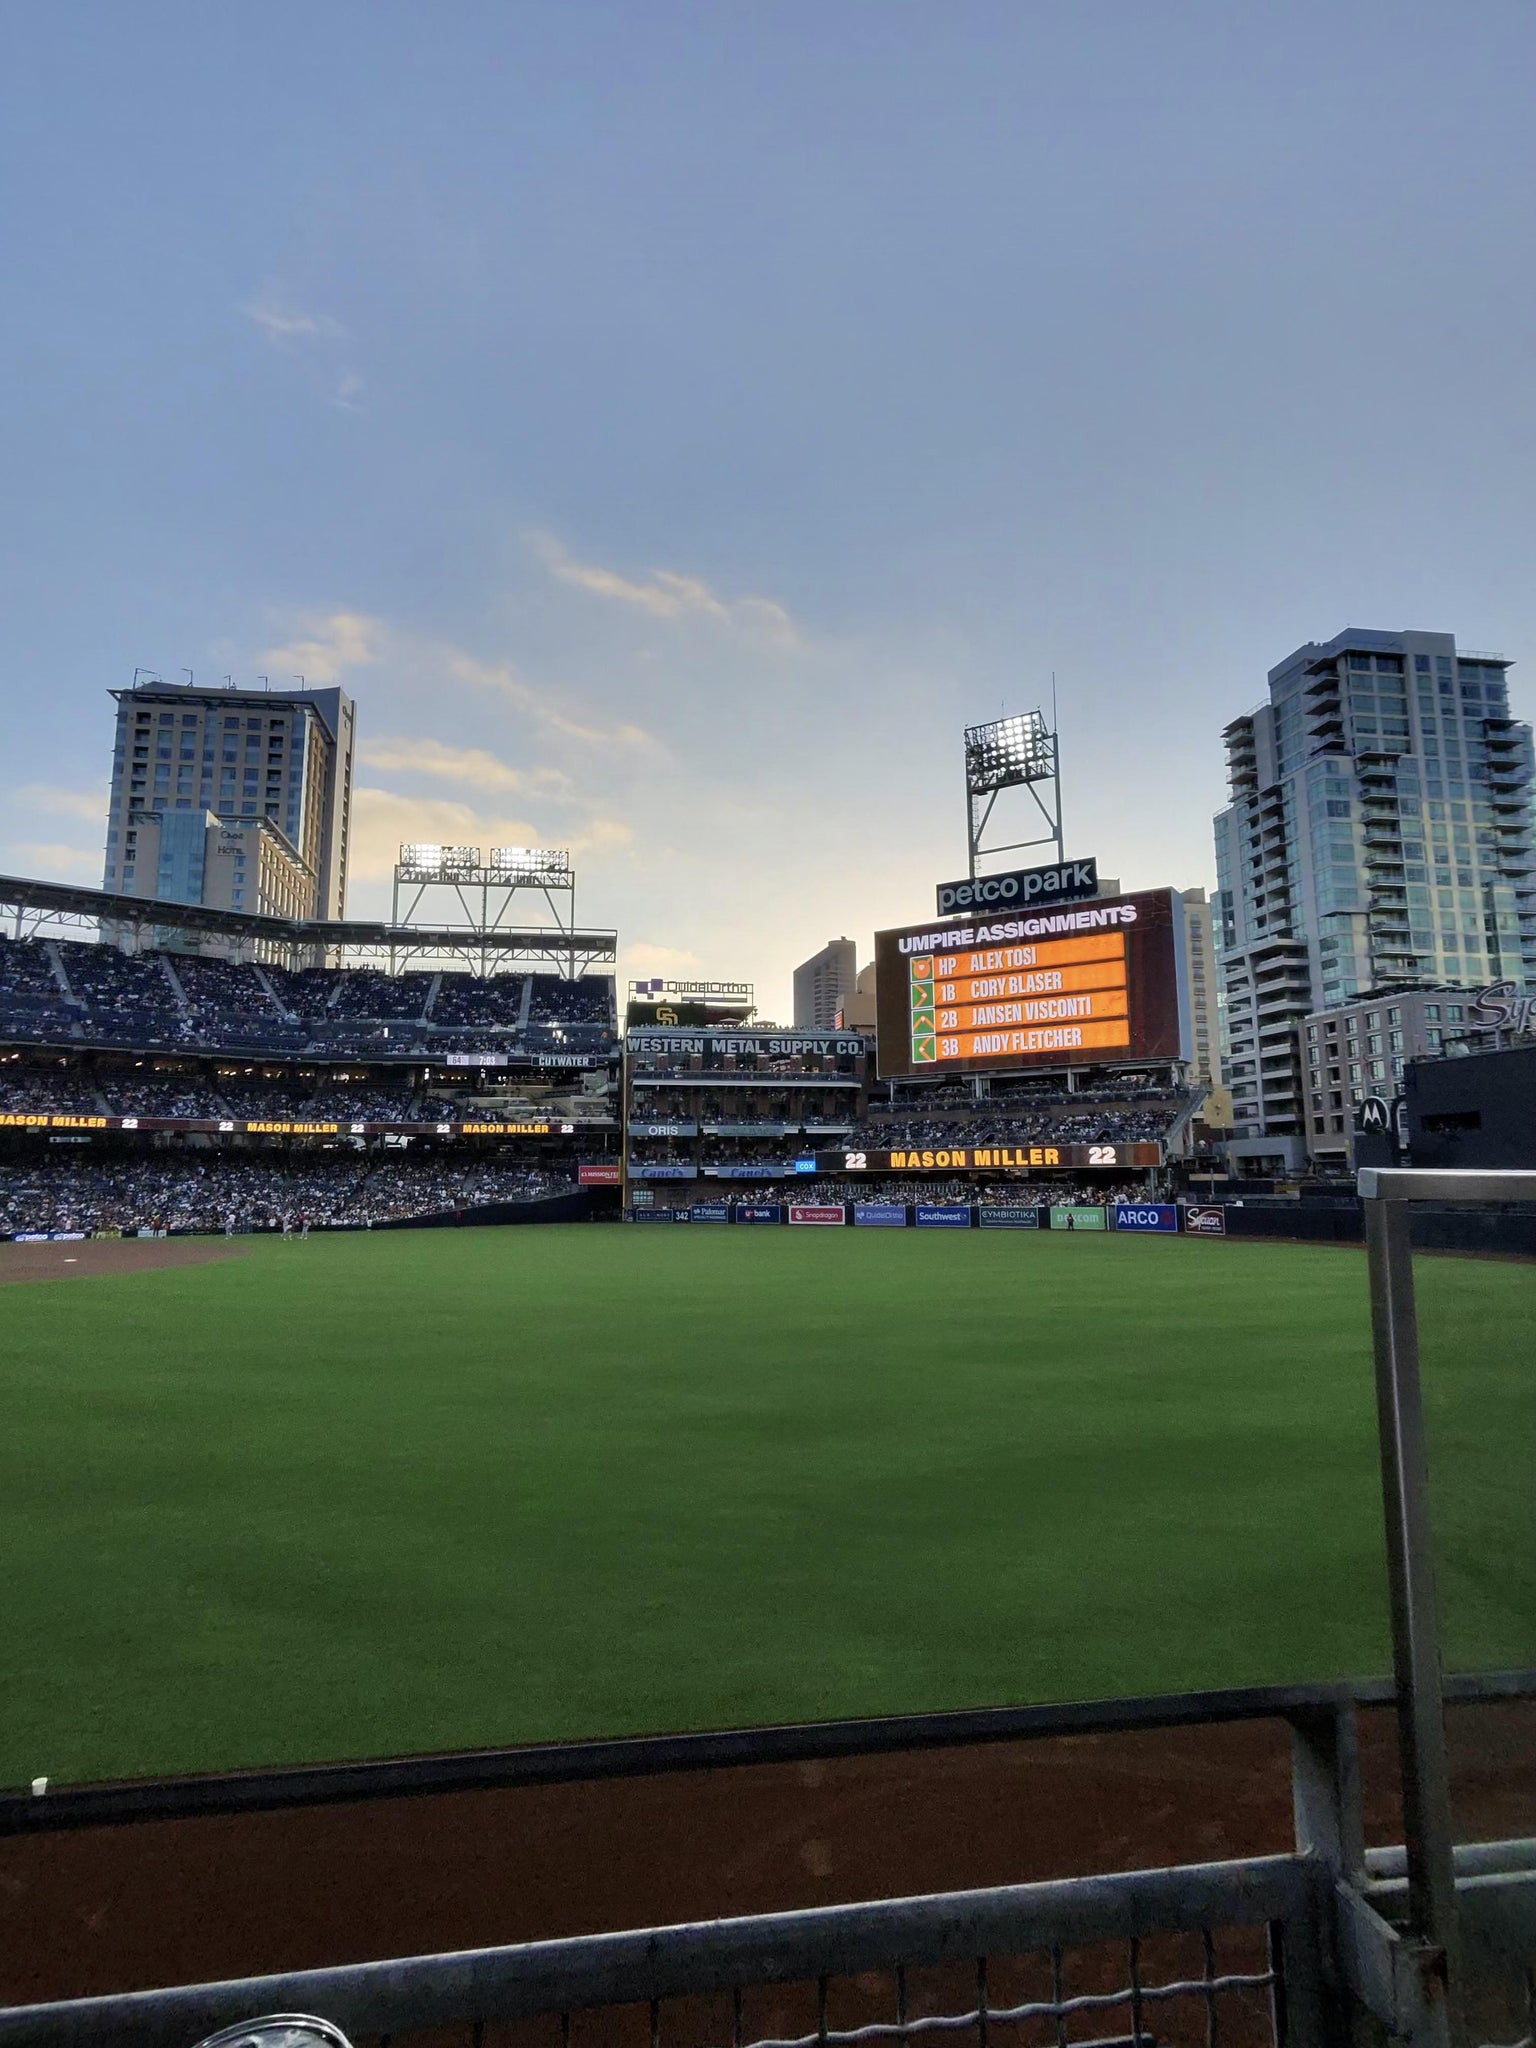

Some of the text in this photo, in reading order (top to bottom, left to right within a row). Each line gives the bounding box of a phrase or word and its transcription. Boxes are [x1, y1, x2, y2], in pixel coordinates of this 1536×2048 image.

[938, 863, 1093, 914] petco park
[898, 905, 1138, 953] UMPIRE ASSIGNMENTS
[970, 947, 1037, 972] ALEX TOSI
[938, 958, 957, 976] HP
[971, 971, 1062, 999] CORY BLASER
[941, 984, 956, 1002] 1B
[971, 997, 1091, 1026] JANSEN VISCONTI
[941, 1011, 958, 1028] 2B
[627, 1038, 863, 1055] WESTERN METAL SUPPLY CO.
[973, 1028, 1082, 1054] ANDY FLETCHER
[941, 1039, 958, 1056] 3B
[479, 1056, 496, 1065] 7:03
[538, 1057, 589, 1066] CUTWATER
[52, 1116, 106, 1127] MILLER
[121, 1118, 138, 1128] 22
[219, 1121, 234, 1131] 22
[247, 1122, 338, 1133] MASON MILLER
[350, 1124, 364, 1133] 22
[437, 1124, 450, 1133] 22
[462, 1124, 549, 1133] MASON MILLER
[561, 1124, 574, 1133] 22
[648, 1126, 678, 1136] ORIS
[845, 1152, 867, 1169] 22
[890, 1148, 1059, 1168] MASON MILLER
[1088, 1146, 1116, 1165] 22
[675, 1211, 688, 1220] 342
[754, 1209, 771, 1217] bank
[805, 1211, 839, 1219] Snapdragon
[919, 1212, 960, 1220] Southwest
[981, 1210, 1036, 1218] CYMBIOTIKA
[1118, 1211, 1158, 1225] ARCO
